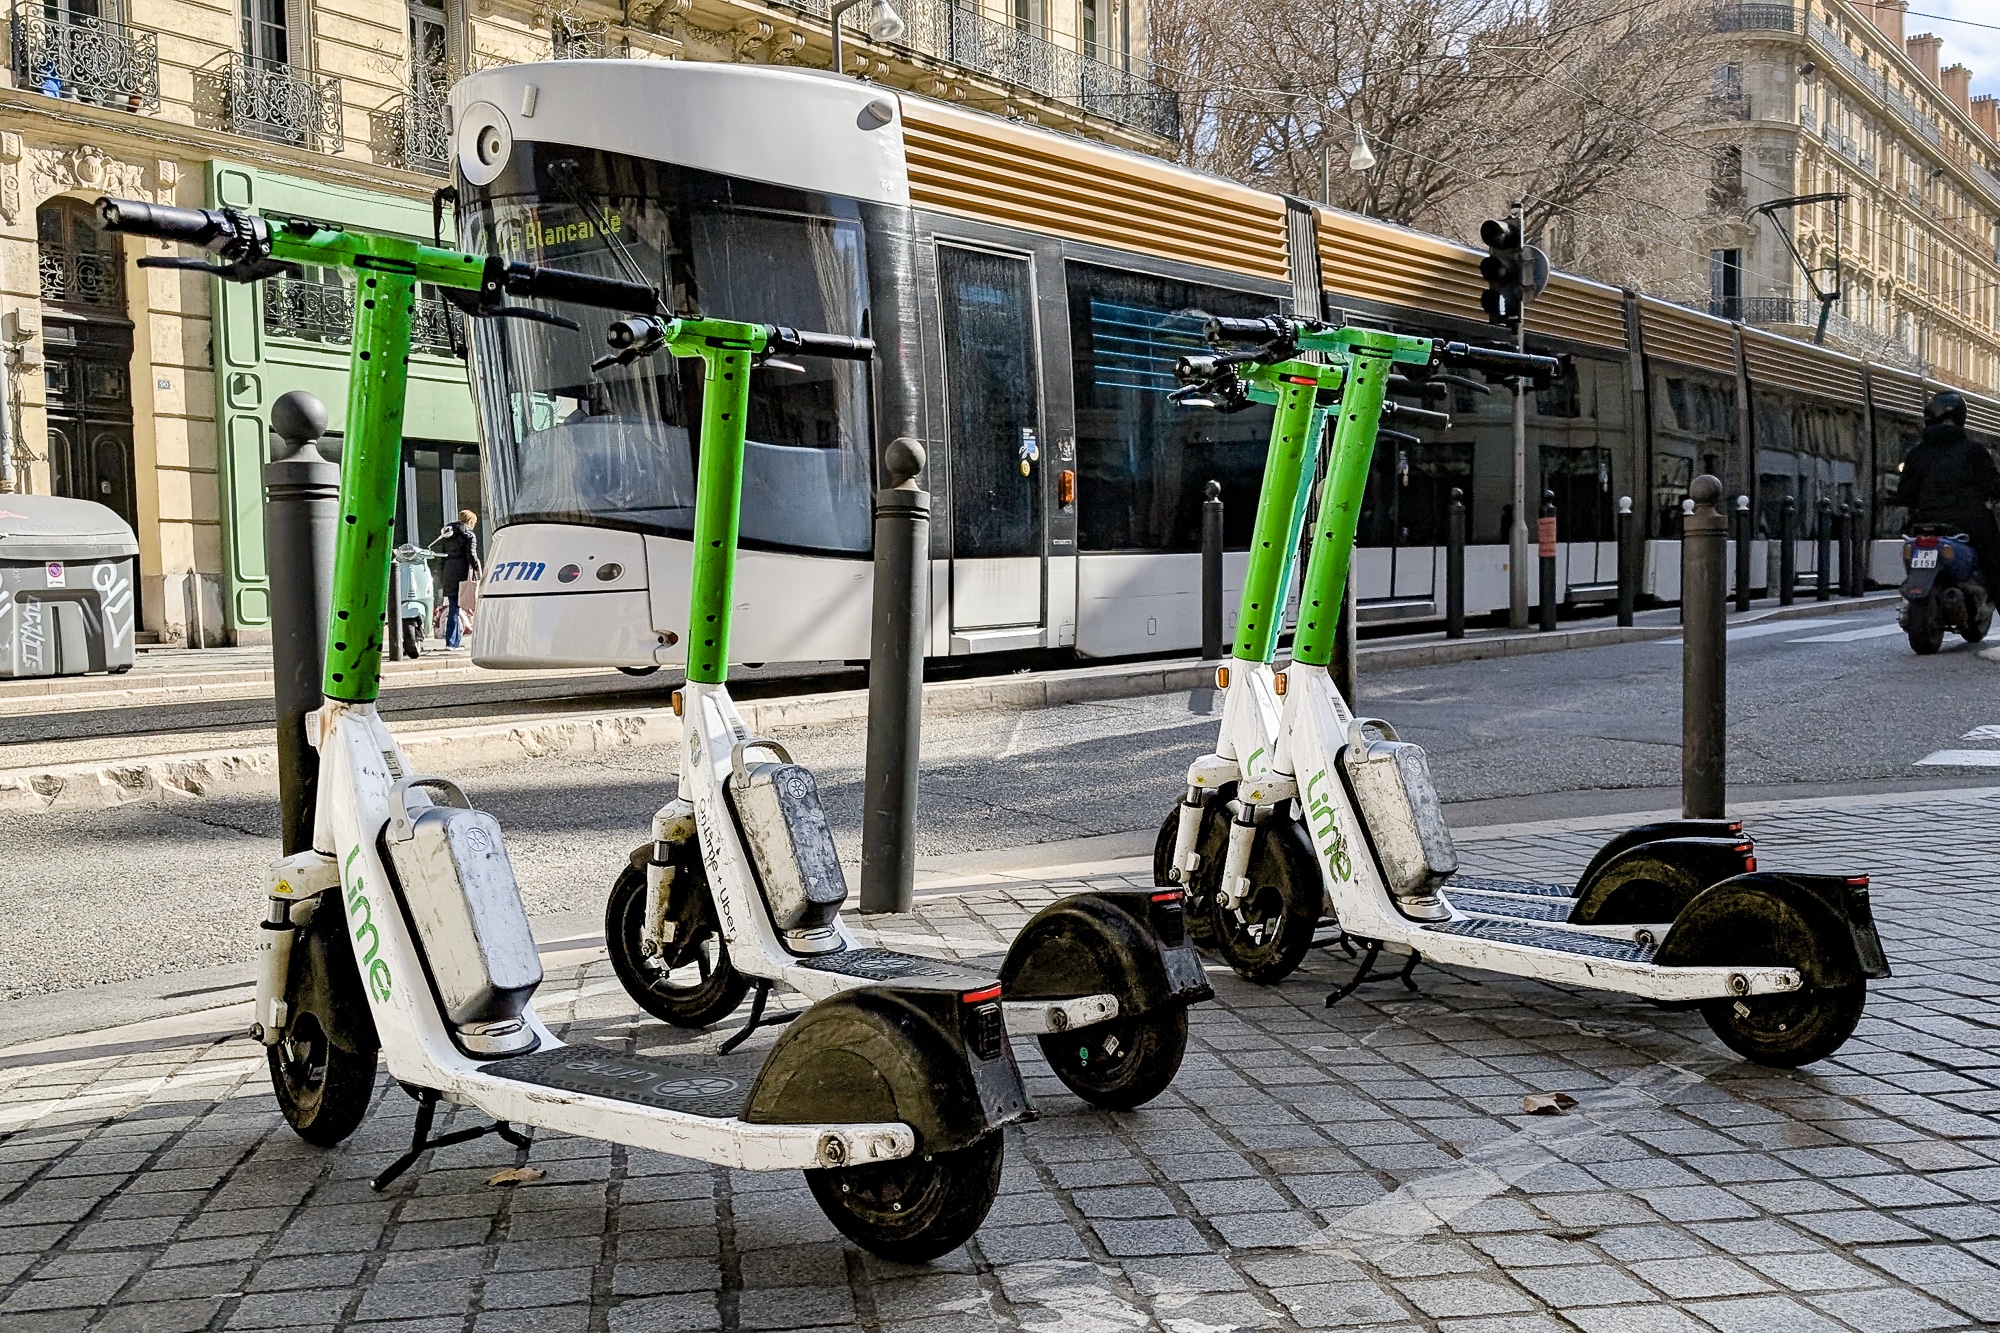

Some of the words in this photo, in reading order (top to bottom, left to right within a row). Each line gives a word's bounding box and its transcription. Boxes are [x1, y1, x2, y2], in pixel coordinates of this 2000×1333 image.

[489, 562, 546, 583] RTM
[1307, 769, 1352, 884] Lime
[345, 844, 392, 1004] Lime
[719, 887, 736, 933] Uber
[564, 1060, 660, 1084] Lime
